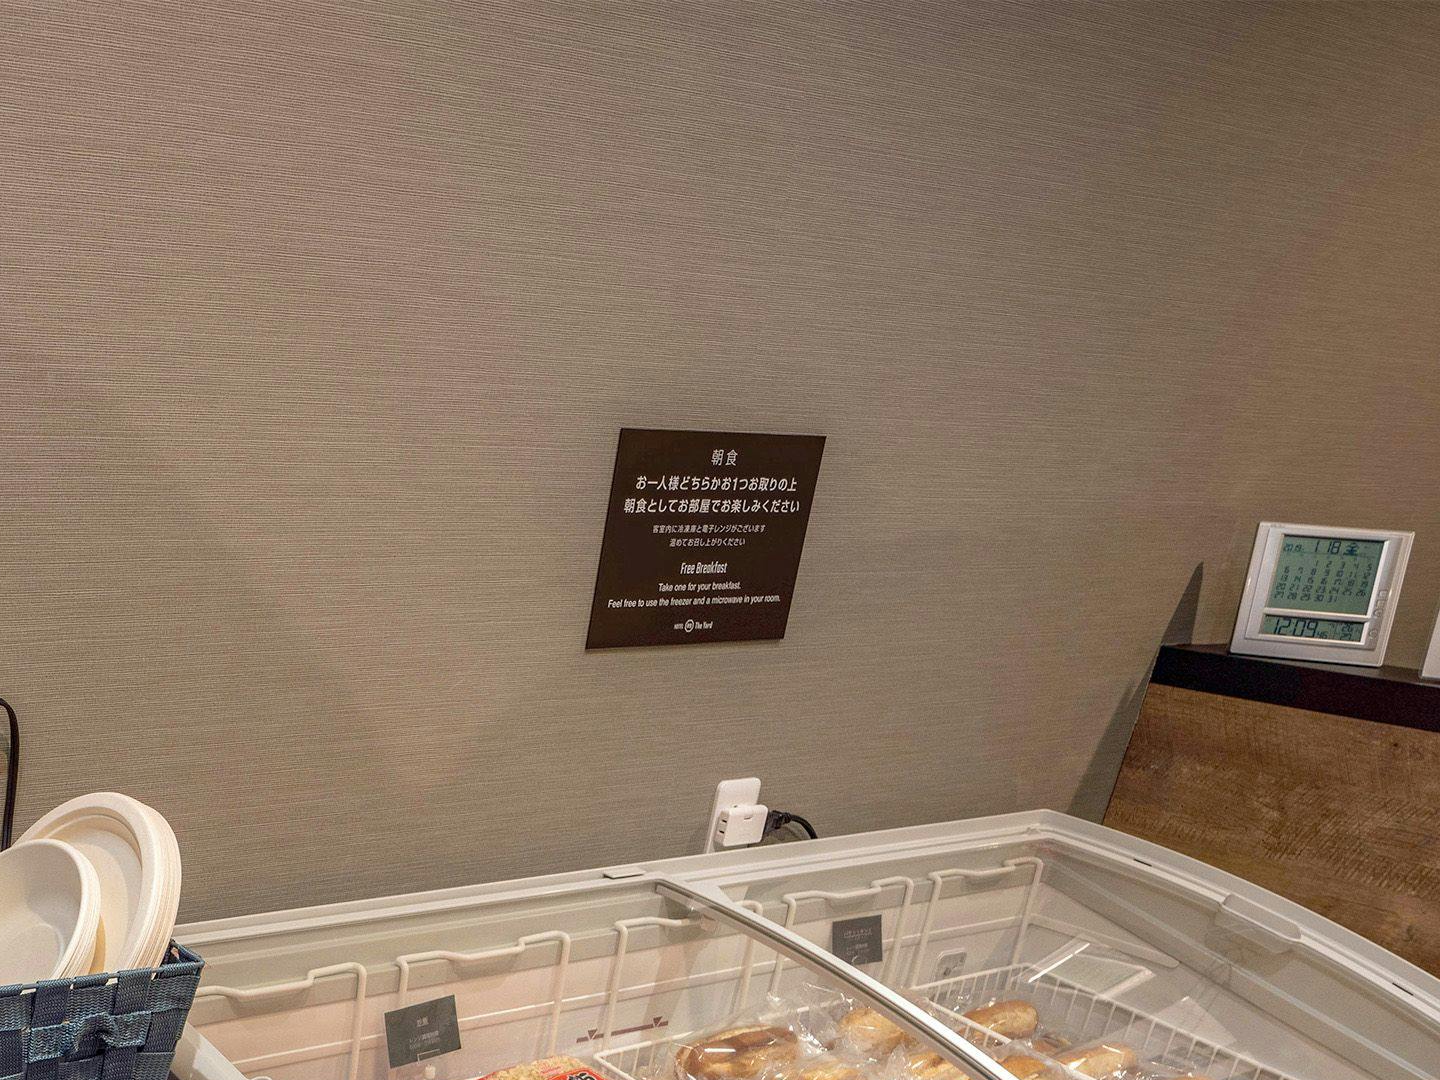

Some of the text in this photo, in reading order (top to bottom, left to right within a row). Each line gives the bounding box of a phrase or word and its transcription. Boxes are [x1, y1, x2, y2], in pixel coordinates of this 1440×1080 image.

[711, 449, 738, 466] 朝食
[635, 475, 798, 492] お一人様どちらかお1つお取りの上
[624, 498, 800, 514] 朝食としてお部屋でお楽しみください
[680, 561, 728, 575] Free Breakfast
[658, 581, 741, 593] Take one for your breakfast.
[607, 599, 623, 608] Feel
[623, 599, 637, 608] free
[637, 598, 645, 607] to
[645, 599, 658, 607] use
[658, 597, 670, 607] the
[670, 597, 692, 606] freezer
[692, 596, 705, 605] and
[711, 595, 744, 604] microwave
[750, 595, 764, 605] your
